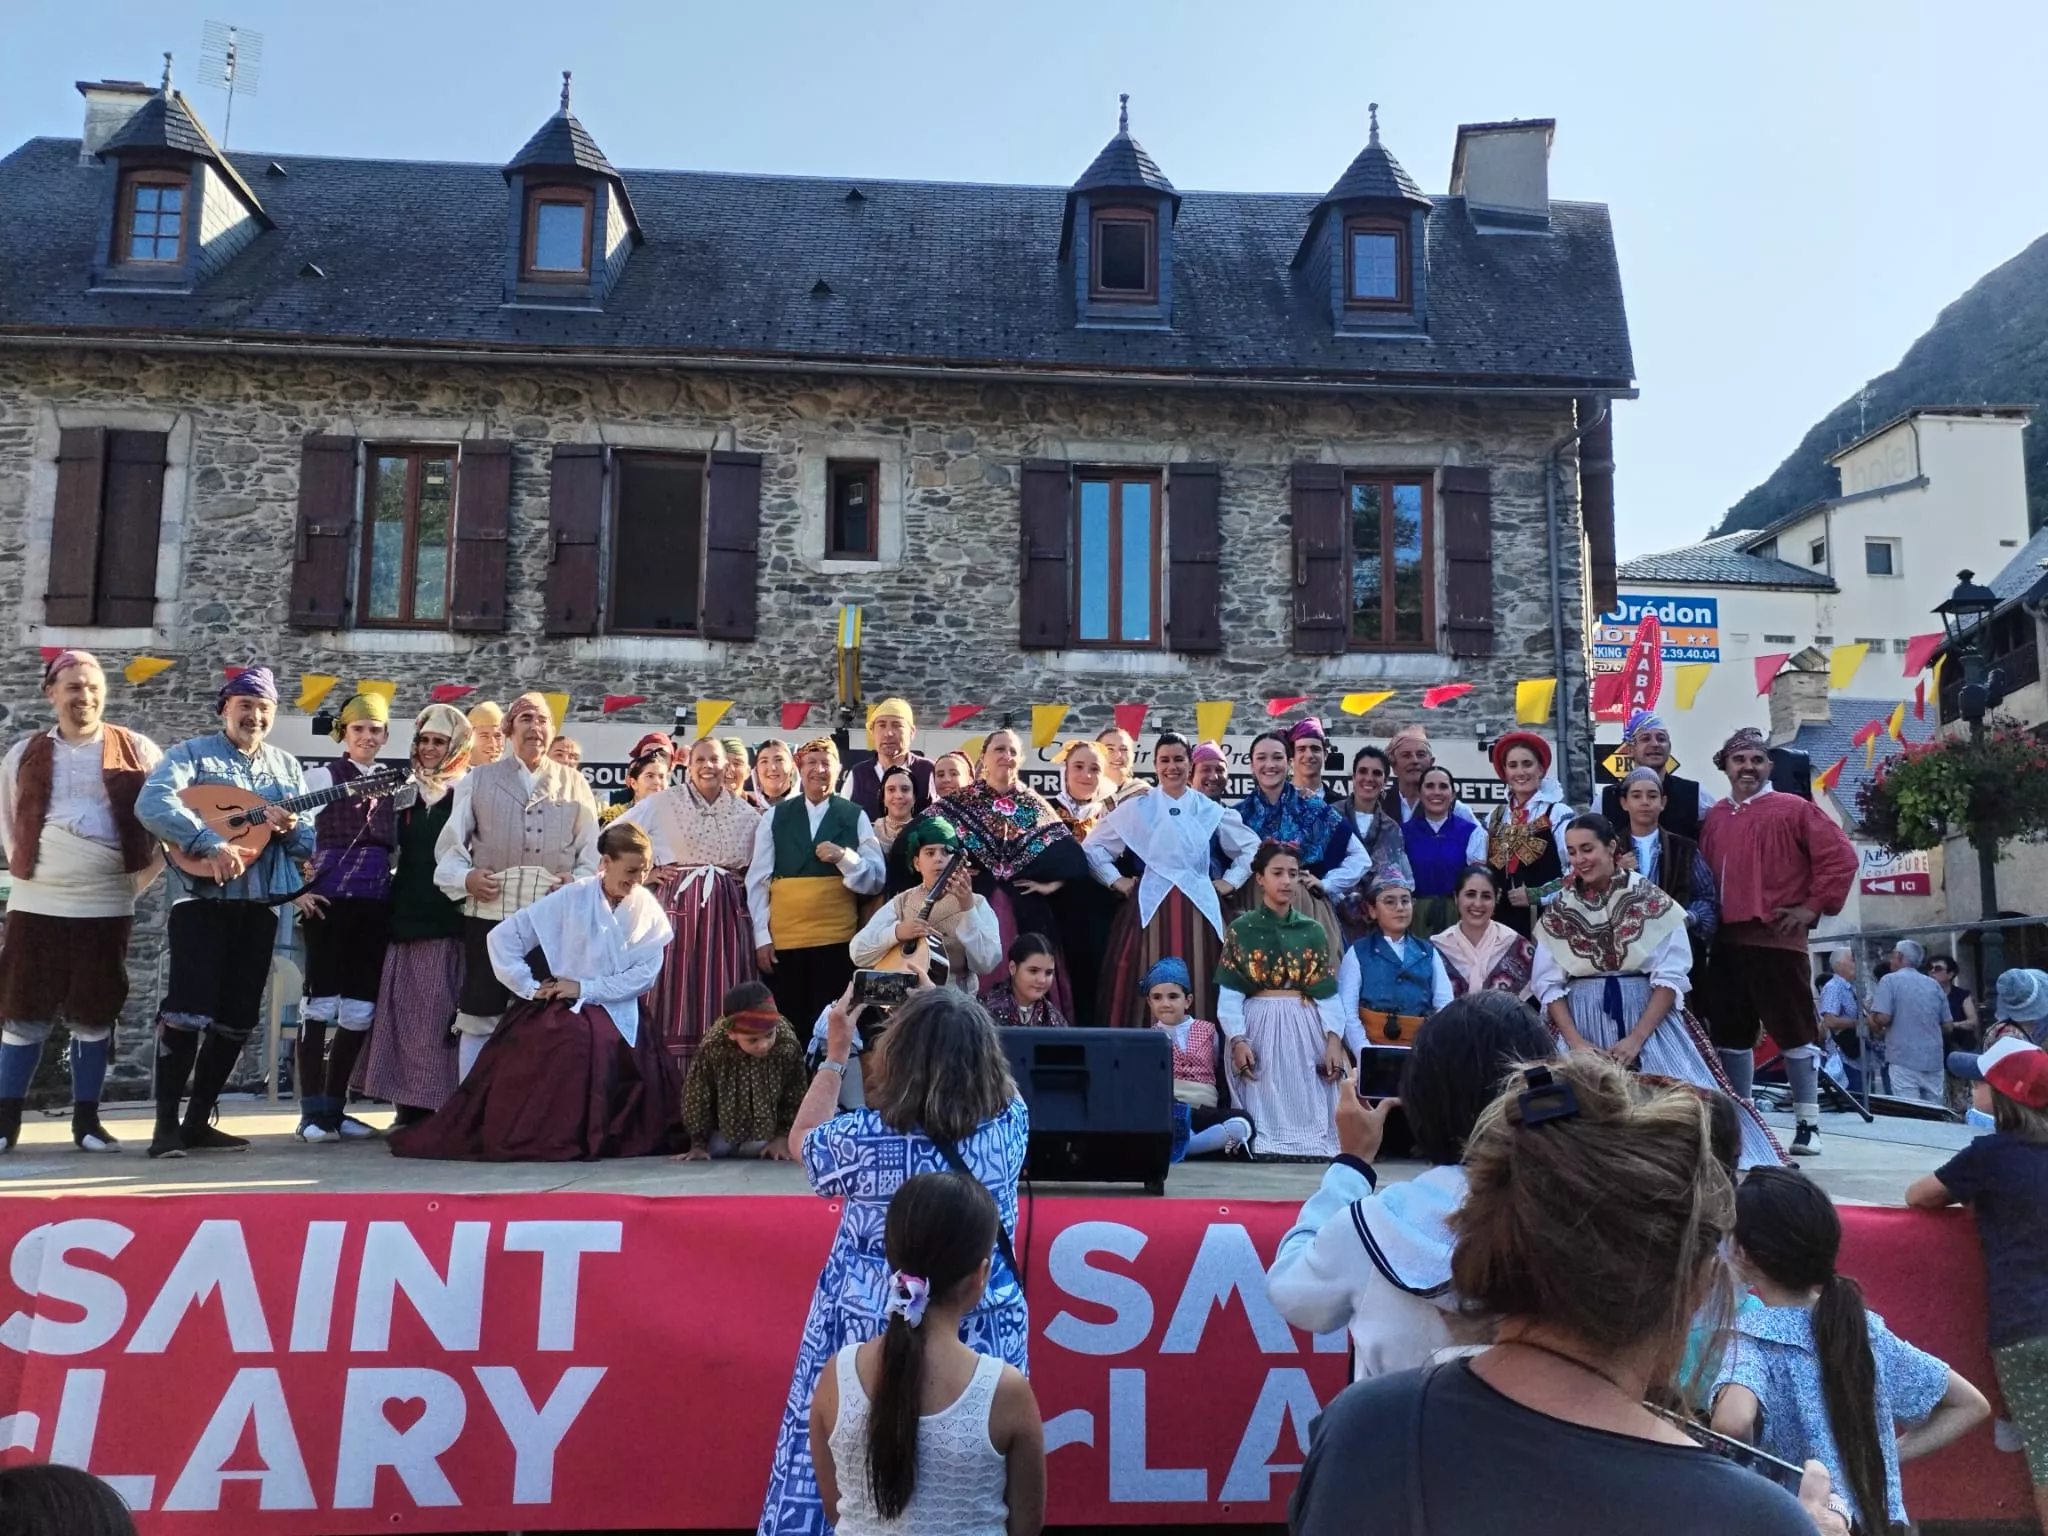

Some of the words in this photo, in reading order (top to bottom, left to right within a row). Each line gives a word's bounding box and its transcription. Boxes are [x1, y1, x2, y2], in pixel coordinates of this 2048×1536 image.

[1607, 600, 1712, 625] Orédon
[1901, 881, 1916, 892] ICI
[0, 1218, 622, 1355] SAINT
